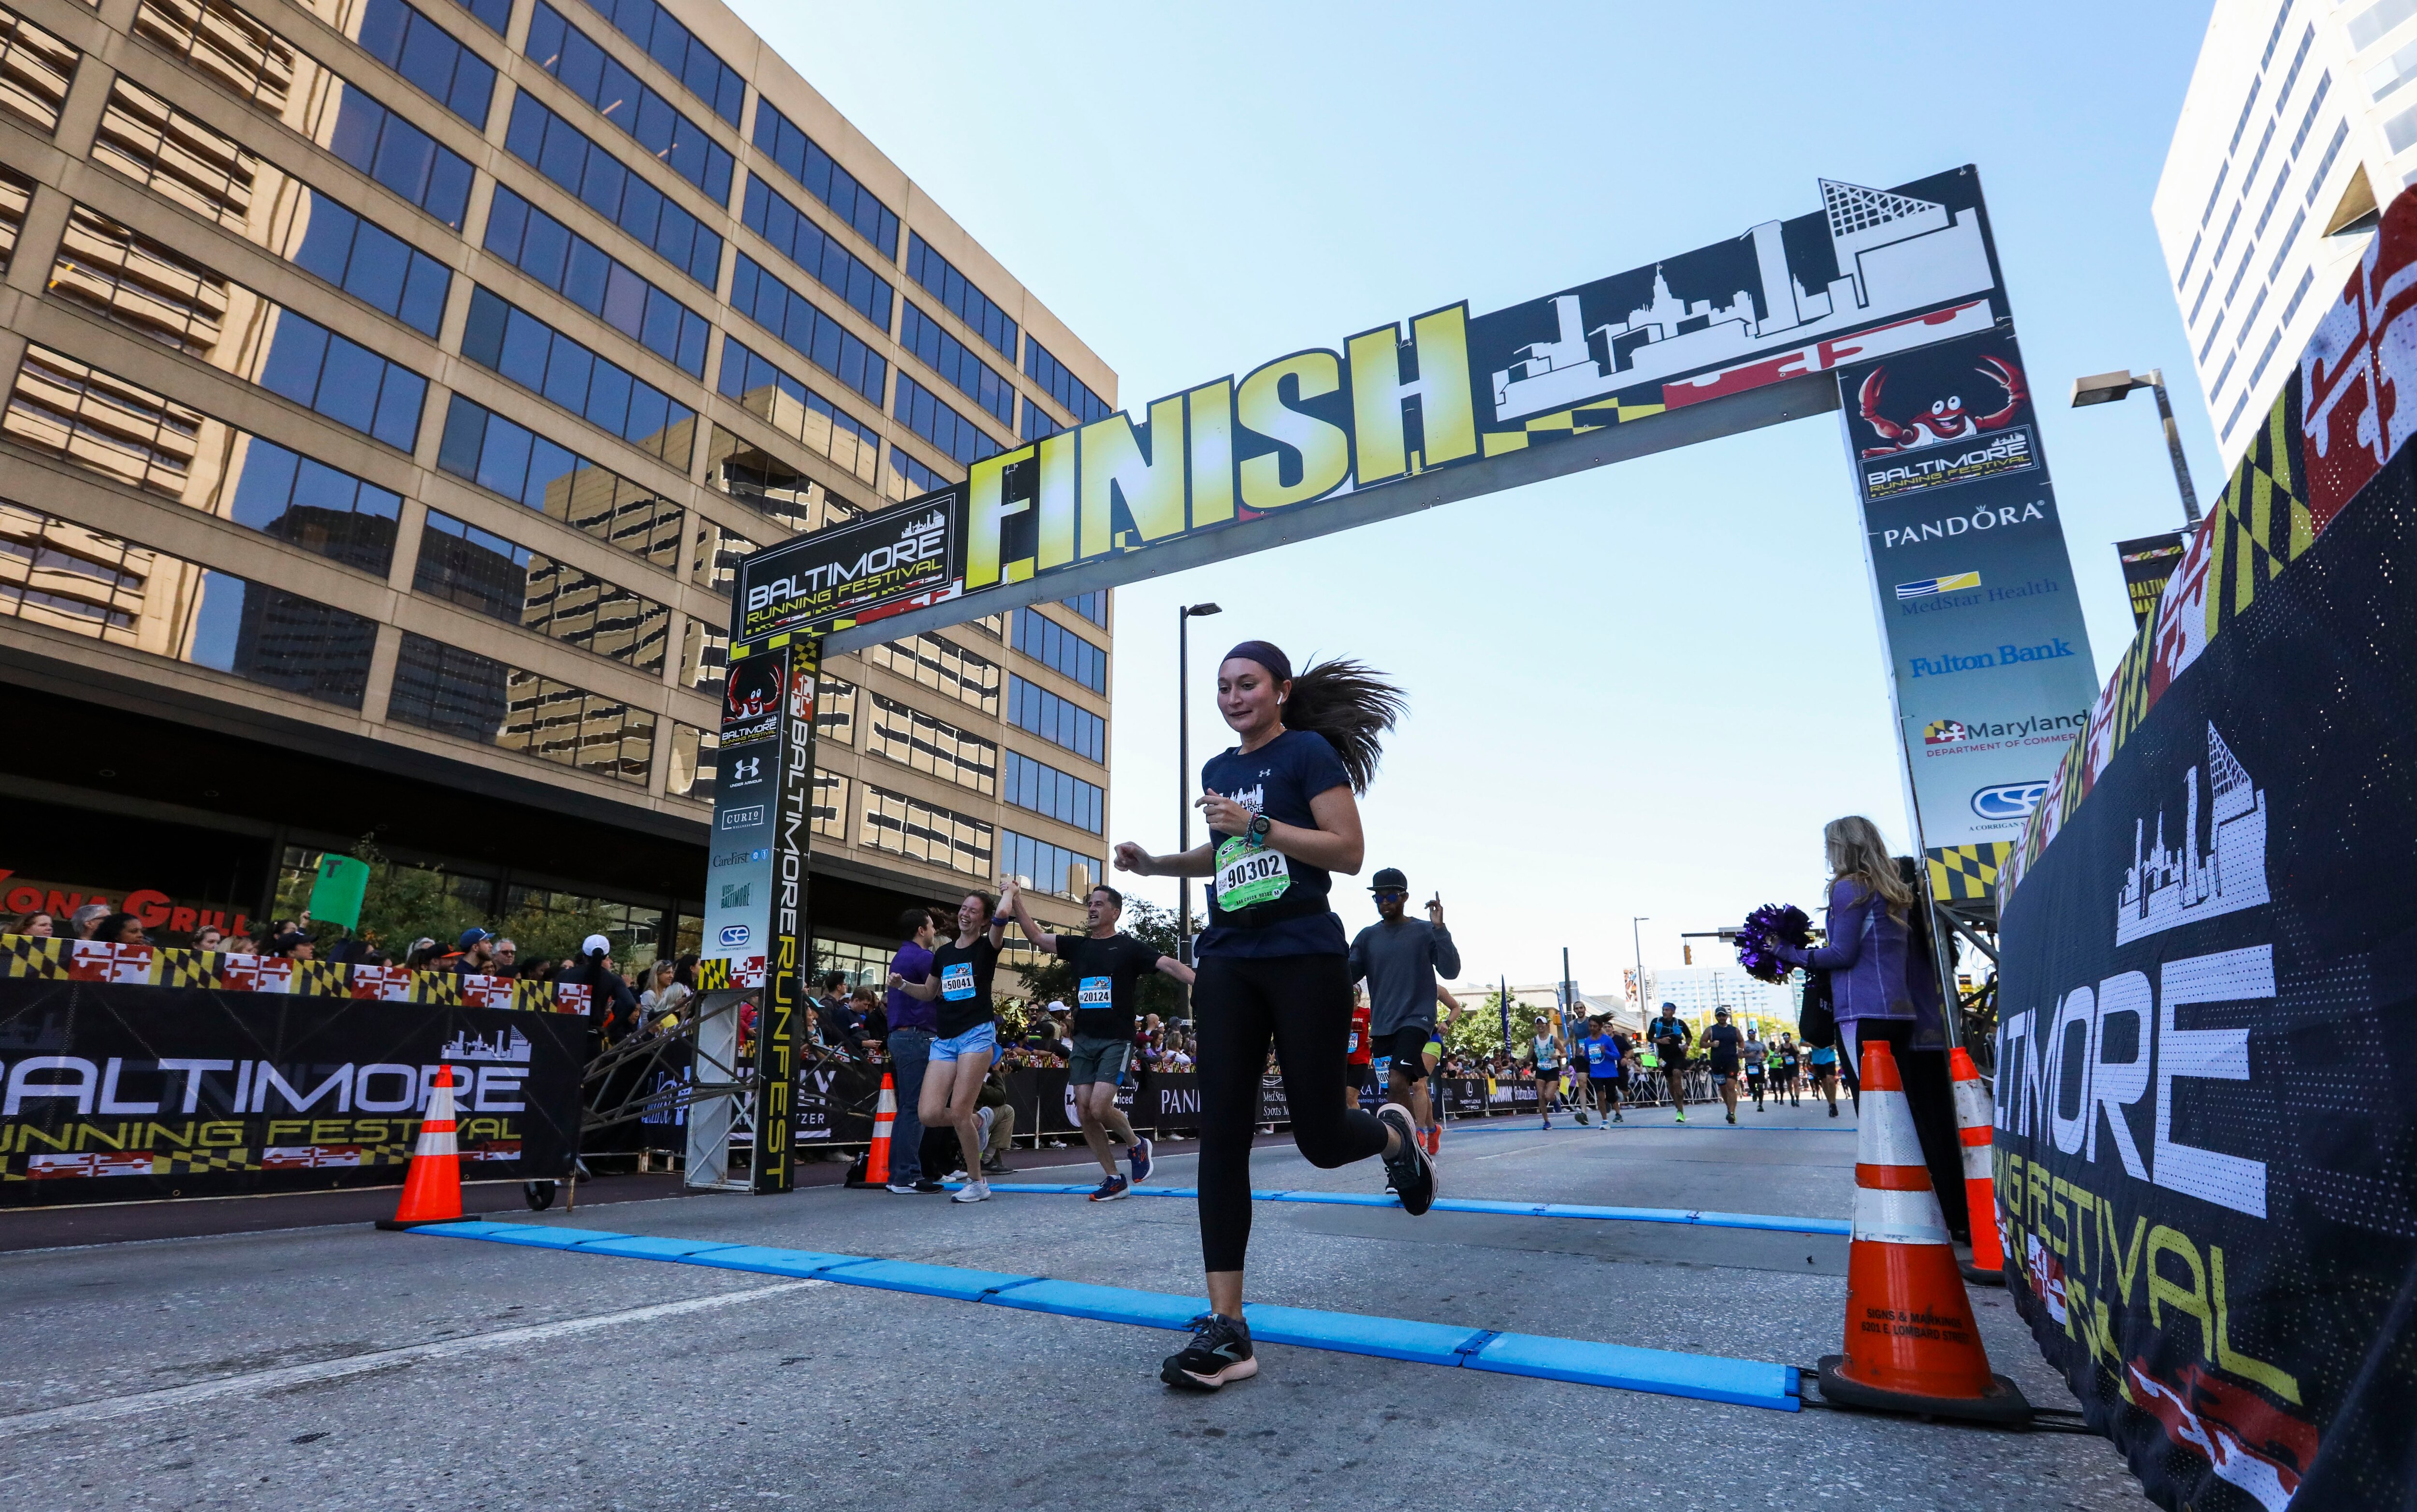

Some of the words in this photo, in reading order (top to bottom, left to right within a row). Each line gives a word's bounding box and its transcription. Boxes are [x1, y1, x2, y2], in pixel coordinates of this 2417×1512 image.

[965, 305, 1477, 590] FINISH
[1867, 441, 2028, 485] BALTIMORE
[1869, 472, 1943, 493] RUNNING
[1948, 455, 2031, 476] FESTIVAL
[748, 529, 944, 611] BALTIMORE
[747, 589, 831, 625] RUNNING
[838, 558, 942, 598] FESTIVAL
[1902, 593, 1980, 616] MedStar
[1988, 579, 2059, 602] Health
[1910, 652, 1995, 678] Fulton
[1998, 638, 2074, 666] Bank
[721, 736, 747, 745] RUNNING
[747, 730, 776, 740] FESTIVAL
[722, 721, 777, 741] BALTIMORE
[1967, 709, 2087, 740] Maryland
[1927, 741, 2001, 757] DEPARTMENT
[2005, 739, 2021, 748] OF
[1976, 822, 2018, 831] CORRIGAN
[326, 860, 343, 878] T
[713, 852, 750, 868] CareFirst
[1228, 855, 1282, 888] 90302
[0, 869, 107, 918] ON
[122, 889, 250, 937] GRILL
[721, 882, 751, 909] BALTIMORE
[722, 884, 734, 897] VISIT
[947, 977, 972, 990] 50041
[1084, 991, 1109, 1002] 20124
[0, 1056, 530, 1115] ALTIMORE
[1514, 1086, 1527, 1100] Fulton
[1161, 1089, 1201, 1114] PAN
[1263, 1105, 1282, 1119] Sports
[0, 1120, 245, 1154] NNING
[266, 1118, 522, 1145] FESTAL
[2027, 1160, 2301, 1406] FESTIVAL
[1861, 1321, 1881, 1333] 6201
[1893, 1324, 1940, 1340] LOMBARD
[1867, 1308, 1895, 1321] SIGNS
[1898, 1311, 1907, 1322] &
[1910, 1312, 1963, 1328] MARKINGS
